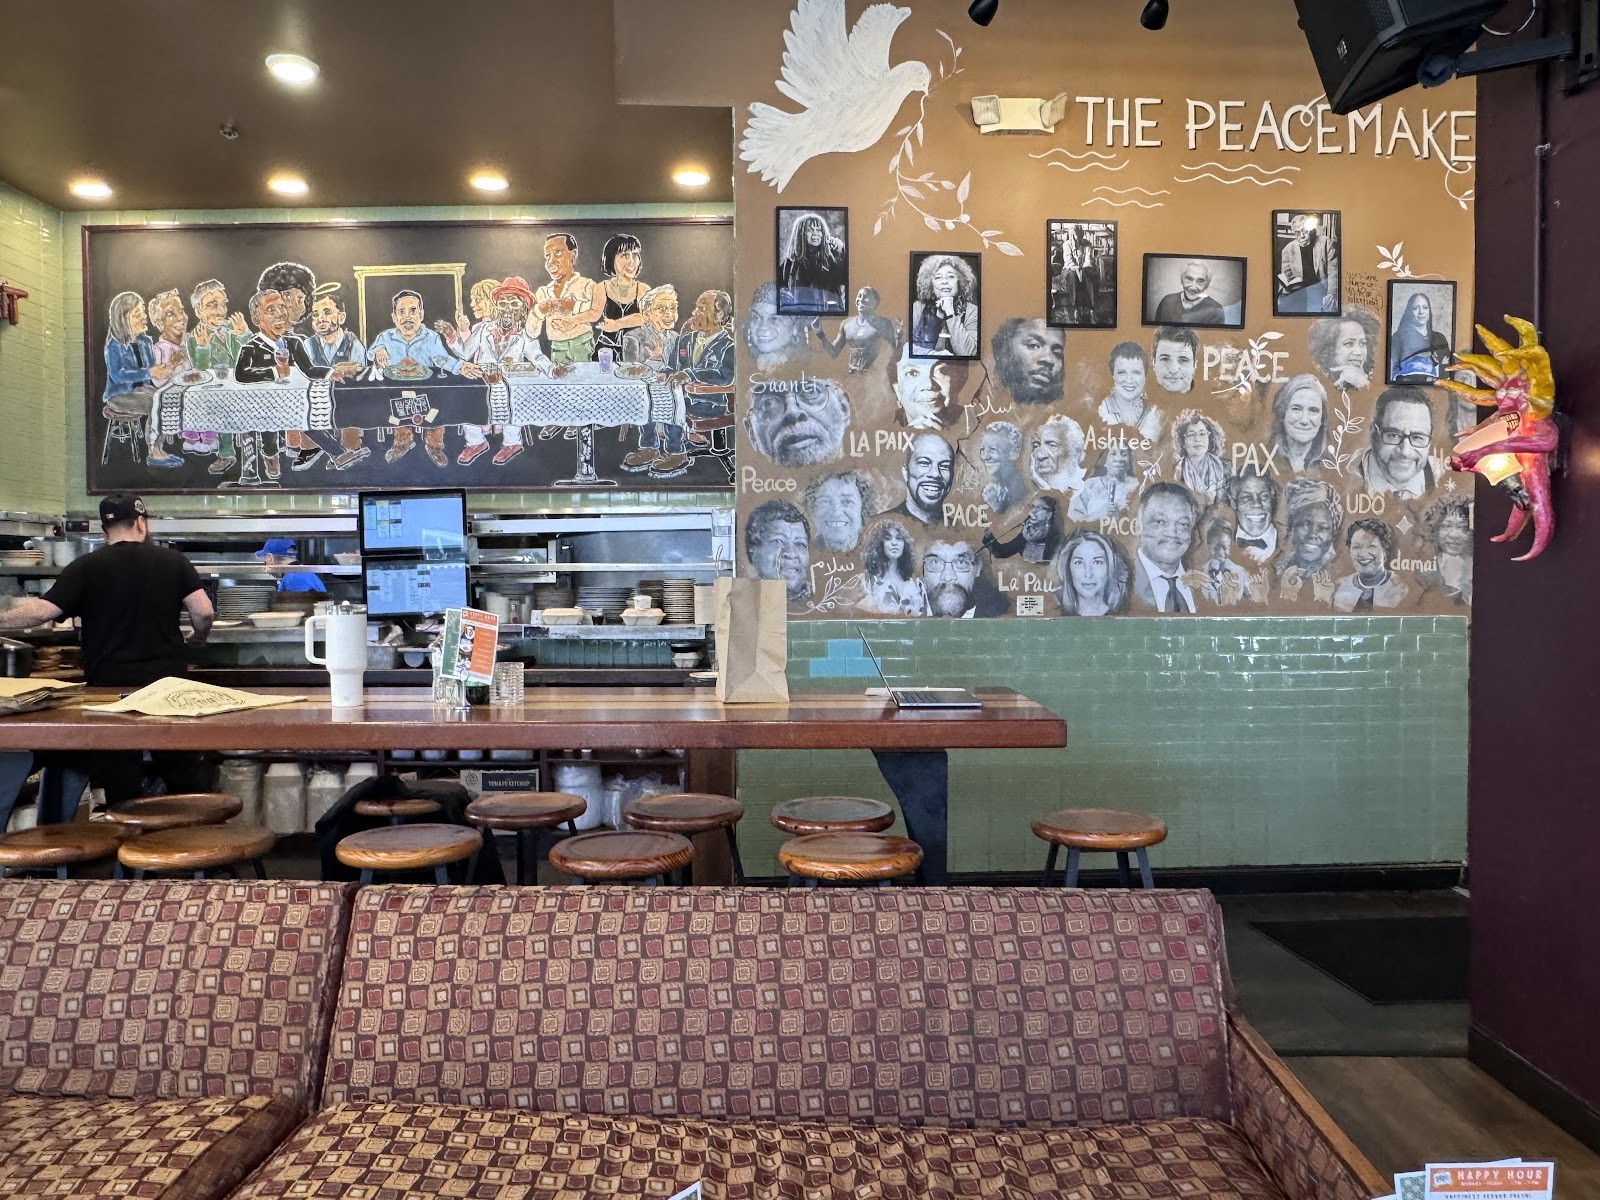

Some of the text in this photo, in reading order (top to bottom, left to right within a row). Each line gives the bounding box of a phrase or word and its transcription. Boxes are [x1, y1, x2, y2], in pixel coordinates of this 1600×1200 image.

[1075, 96, 1162, 147] THE
[1202, 345, 1290, 383] PEACE
[850, 430, 916, 457] LA PAIX
[1083, 424, 1152, 451] Ashtee
[1231, 442, 1280, 477] PAX
[741, 465, 797, 494] Peace
[942, 503, 992, 528] PACE
[1099, 515, 1143, 536] PACO
[1389, 549, 1438, 573] damai
[1457, 1170, 1500, 1180] HAPPY
[1507, 1170, 1543, 1180] HOUR
